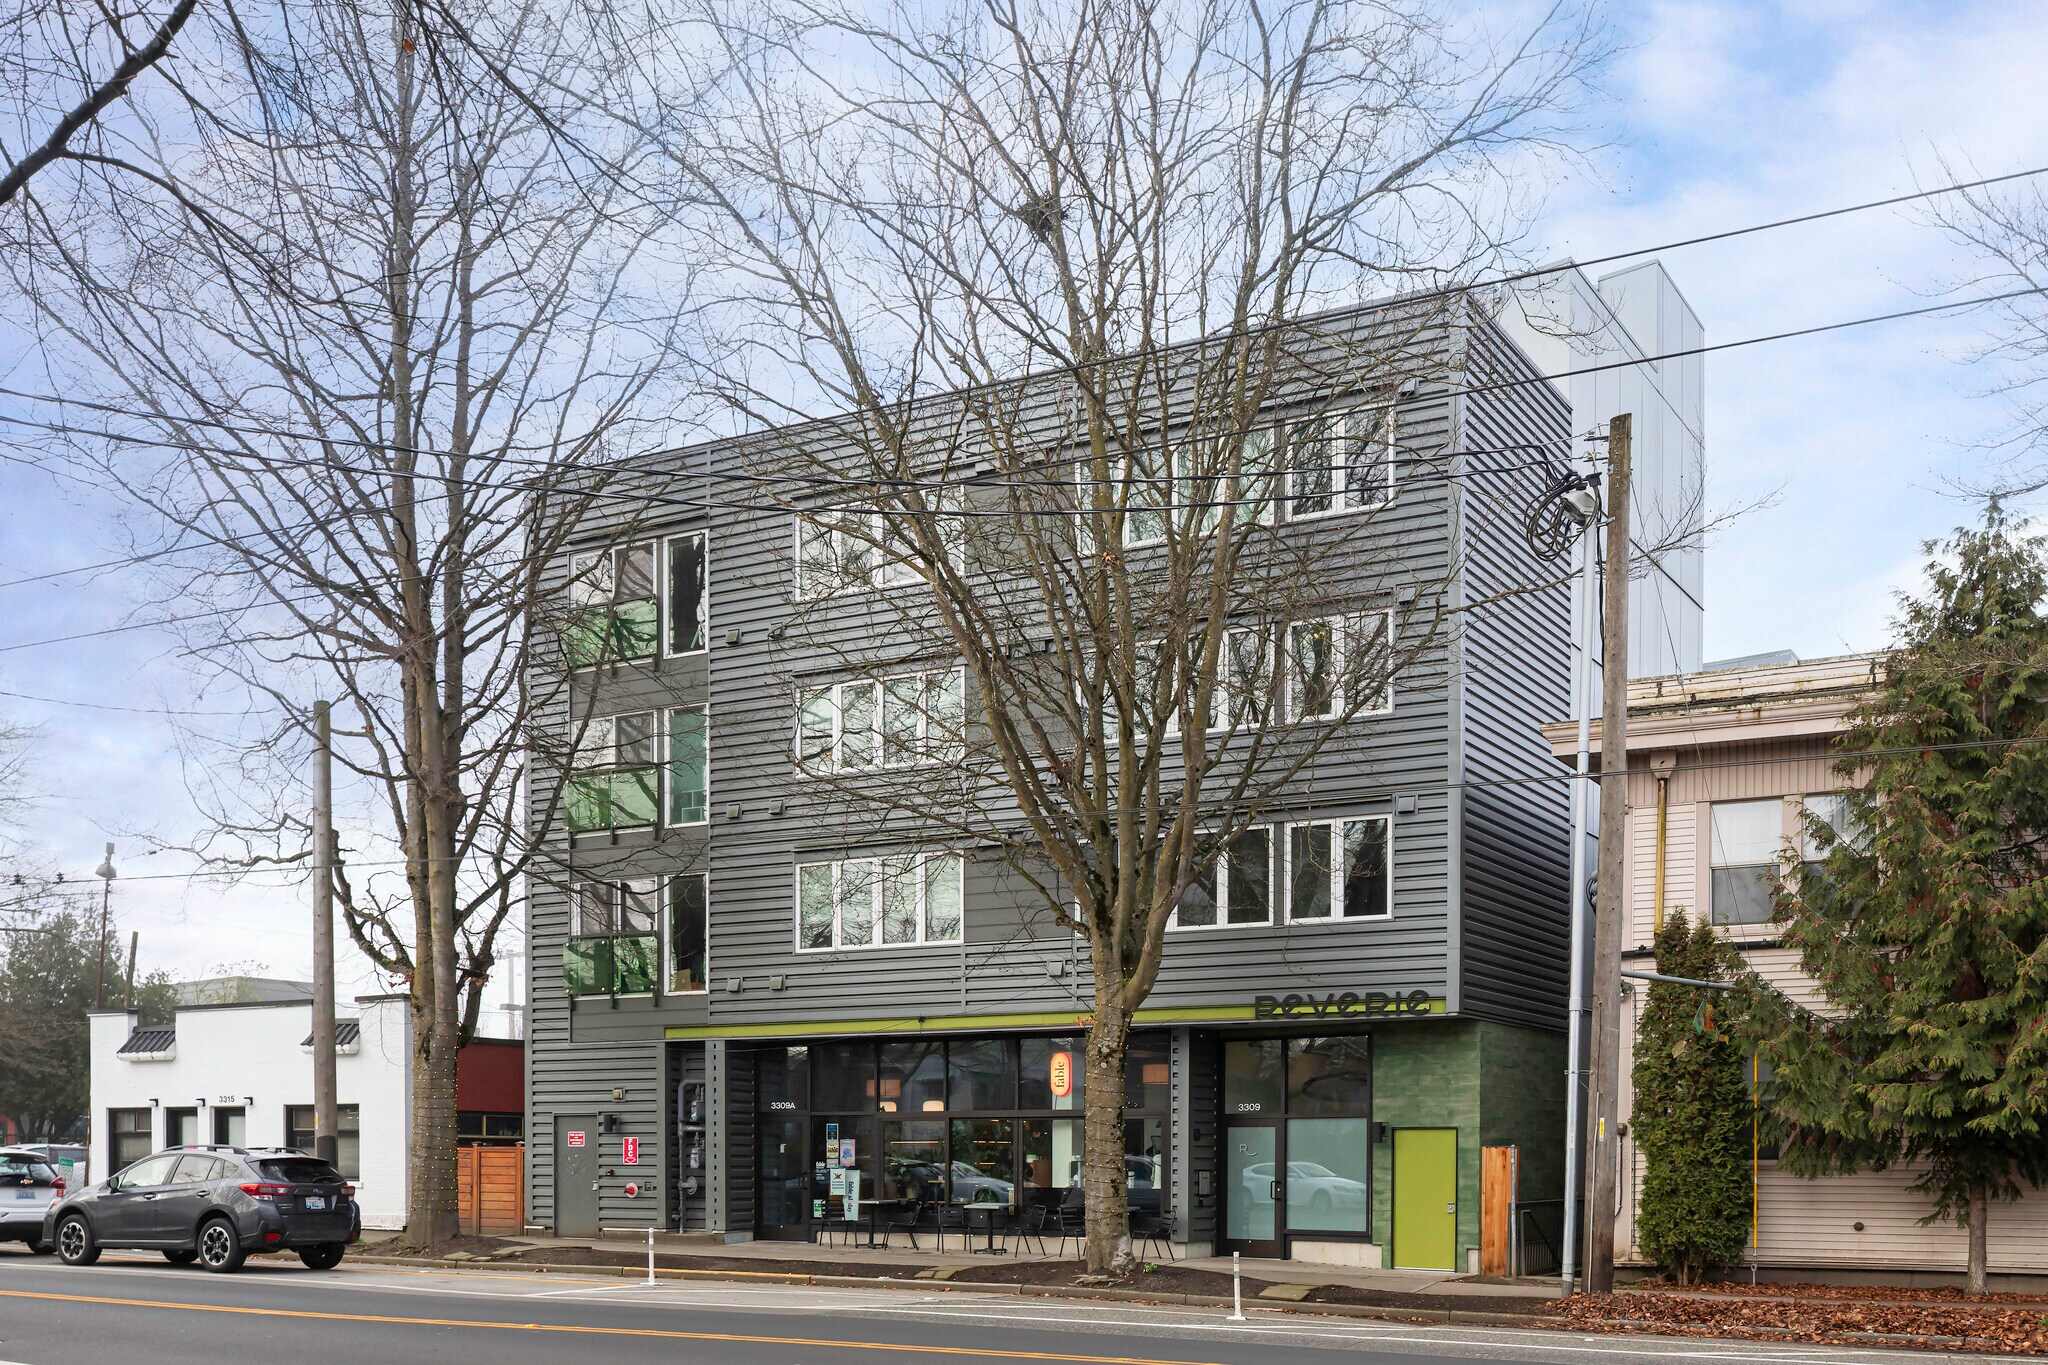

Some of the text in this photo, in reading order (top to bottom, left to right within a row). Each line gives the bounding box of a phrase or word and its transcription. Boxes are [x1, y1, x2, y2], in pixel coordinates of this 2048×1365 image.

[1054, 1061, 1065, 1088] fable
[218, 1095, 235, 1103] 3315
[1238, 1103, 1261, 1112] 3309
